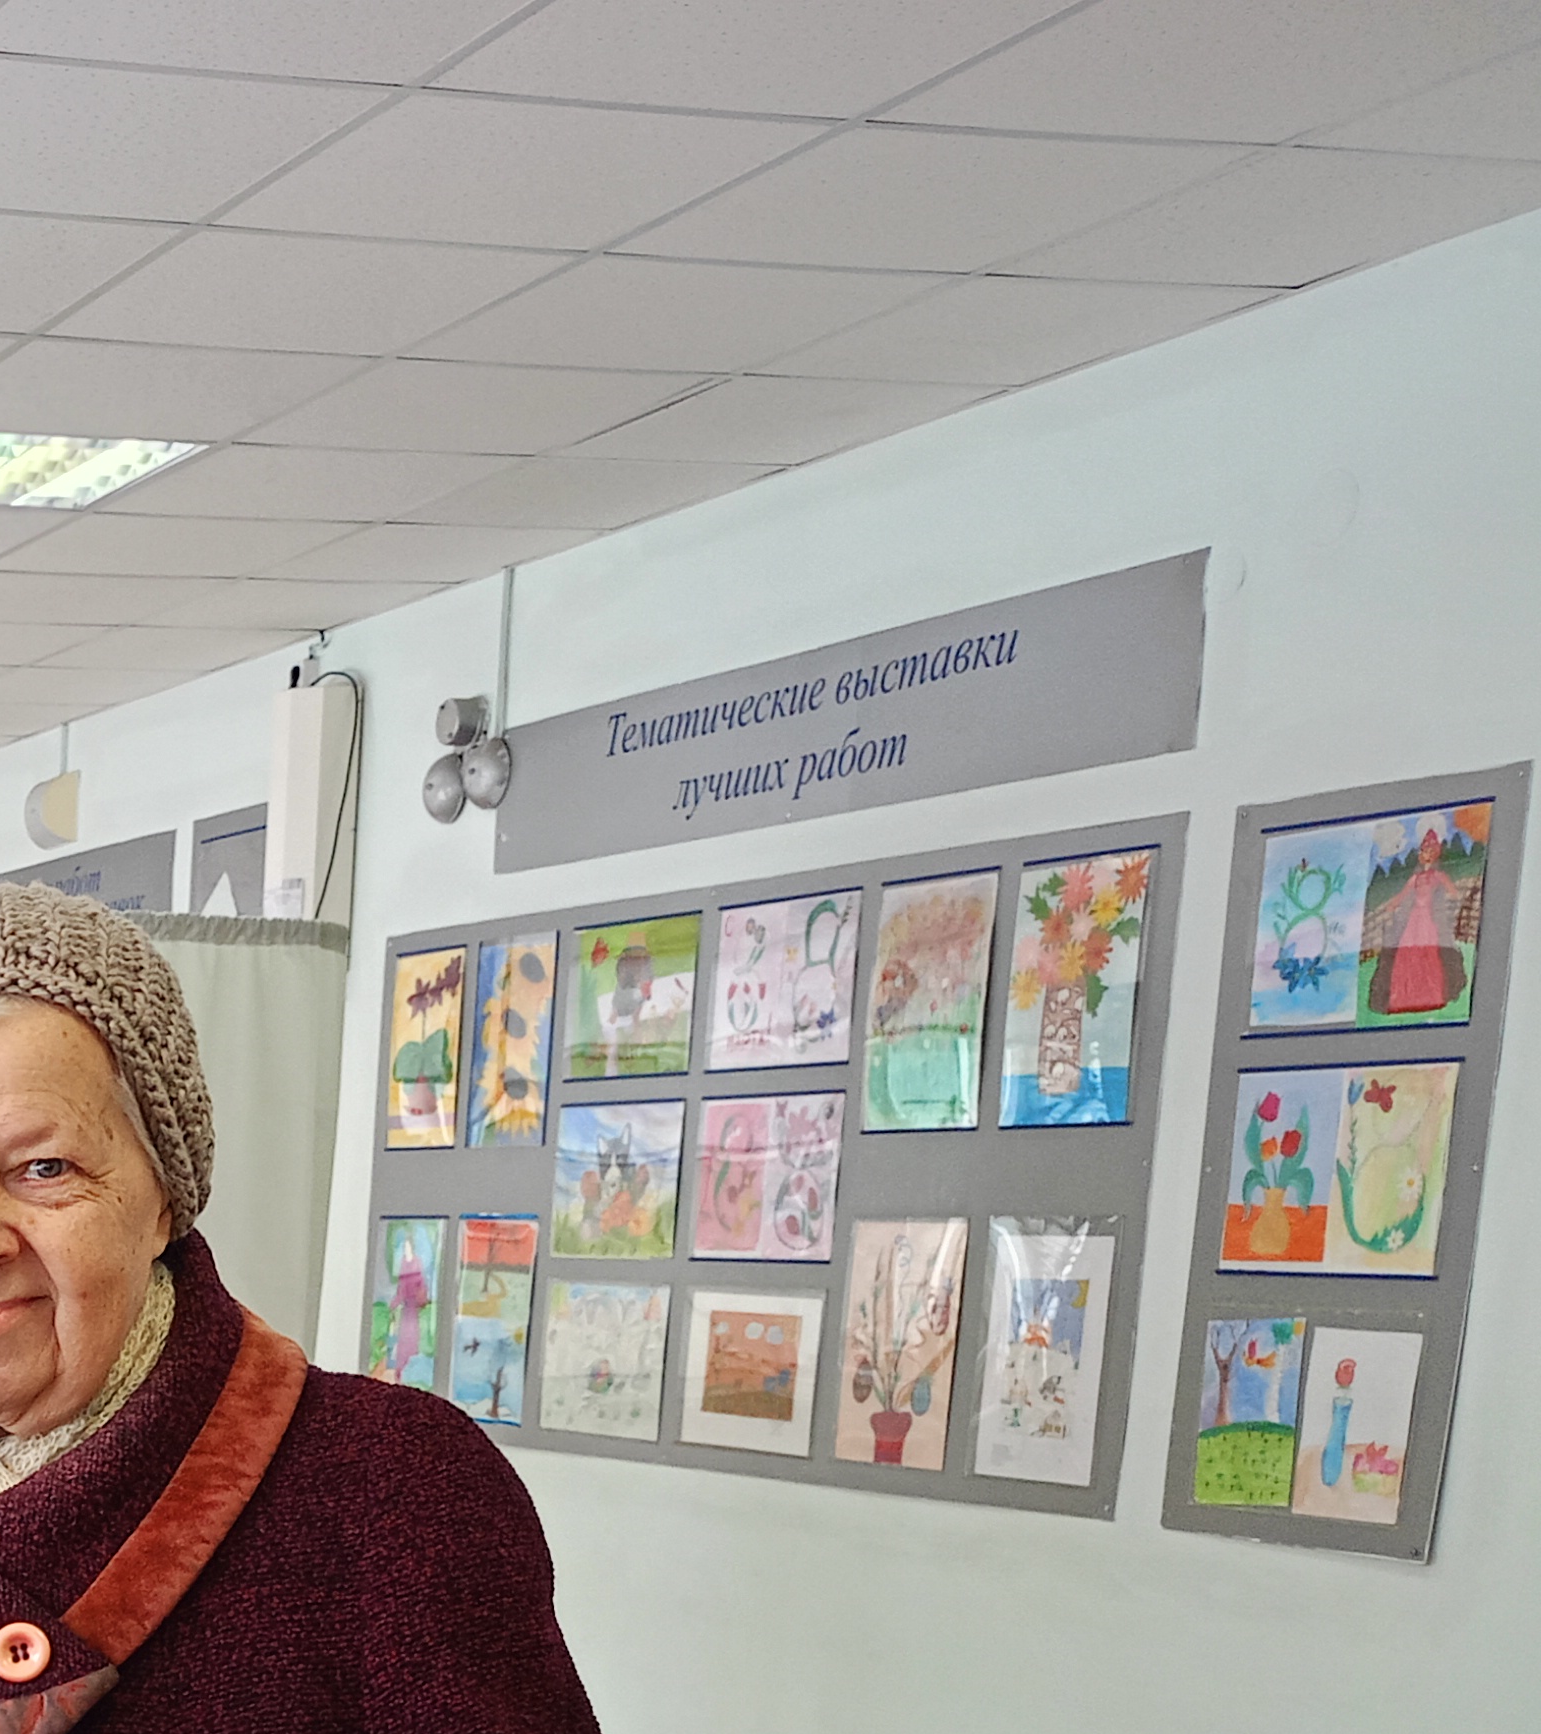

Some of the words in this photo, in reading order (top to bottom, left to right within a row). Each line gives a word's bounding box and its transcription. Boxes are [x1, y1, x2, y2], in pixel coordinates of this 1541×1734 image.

[606, 676, 826, 758] Тематические
[835, 629, 1020, 706] выставки
[671, 757, 790, 821] лучших
[791, 726, 908, 801] работ
